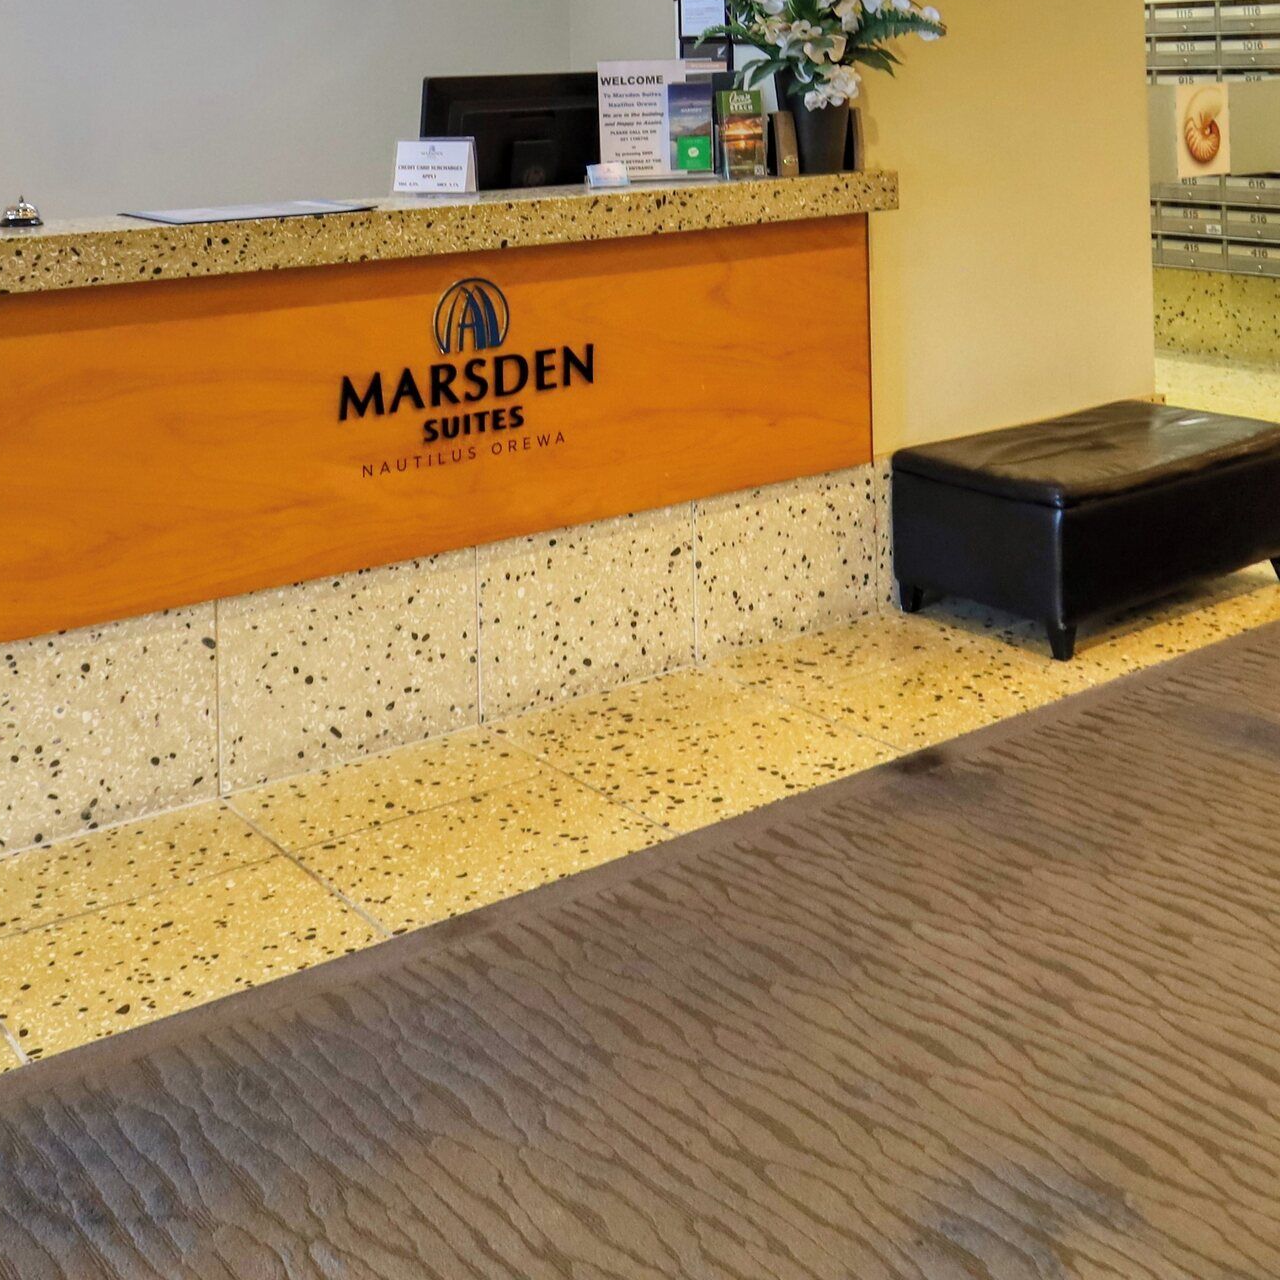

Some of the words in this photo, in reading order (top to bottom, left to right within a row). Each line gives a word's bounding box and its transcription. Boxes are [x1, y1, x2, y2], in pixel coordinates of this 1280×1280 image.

[1176, 9, 1193, 19] 1115
[1243, 6, 1261, 17] 1116
[1176, 42, 1195, 53] 1015
[1243, 40, 1263, 51] 1016
[601, 75, 664, 86] WELCOME
[1249, 179, 1266, 189] 616
[1183, 211, 1199, 219] 515
[1250, 215, 1267, 224] 516
[1184, 244, 1199, 252] 415
[1251, 249, 1268, 258] 416
[339, 344, 594, 420] MARSDEN
[424, 406, 524, 442] SUITES
[363, 446, 476, 478] NAUTILUS
[491, 432, 565, 456] OREWA
